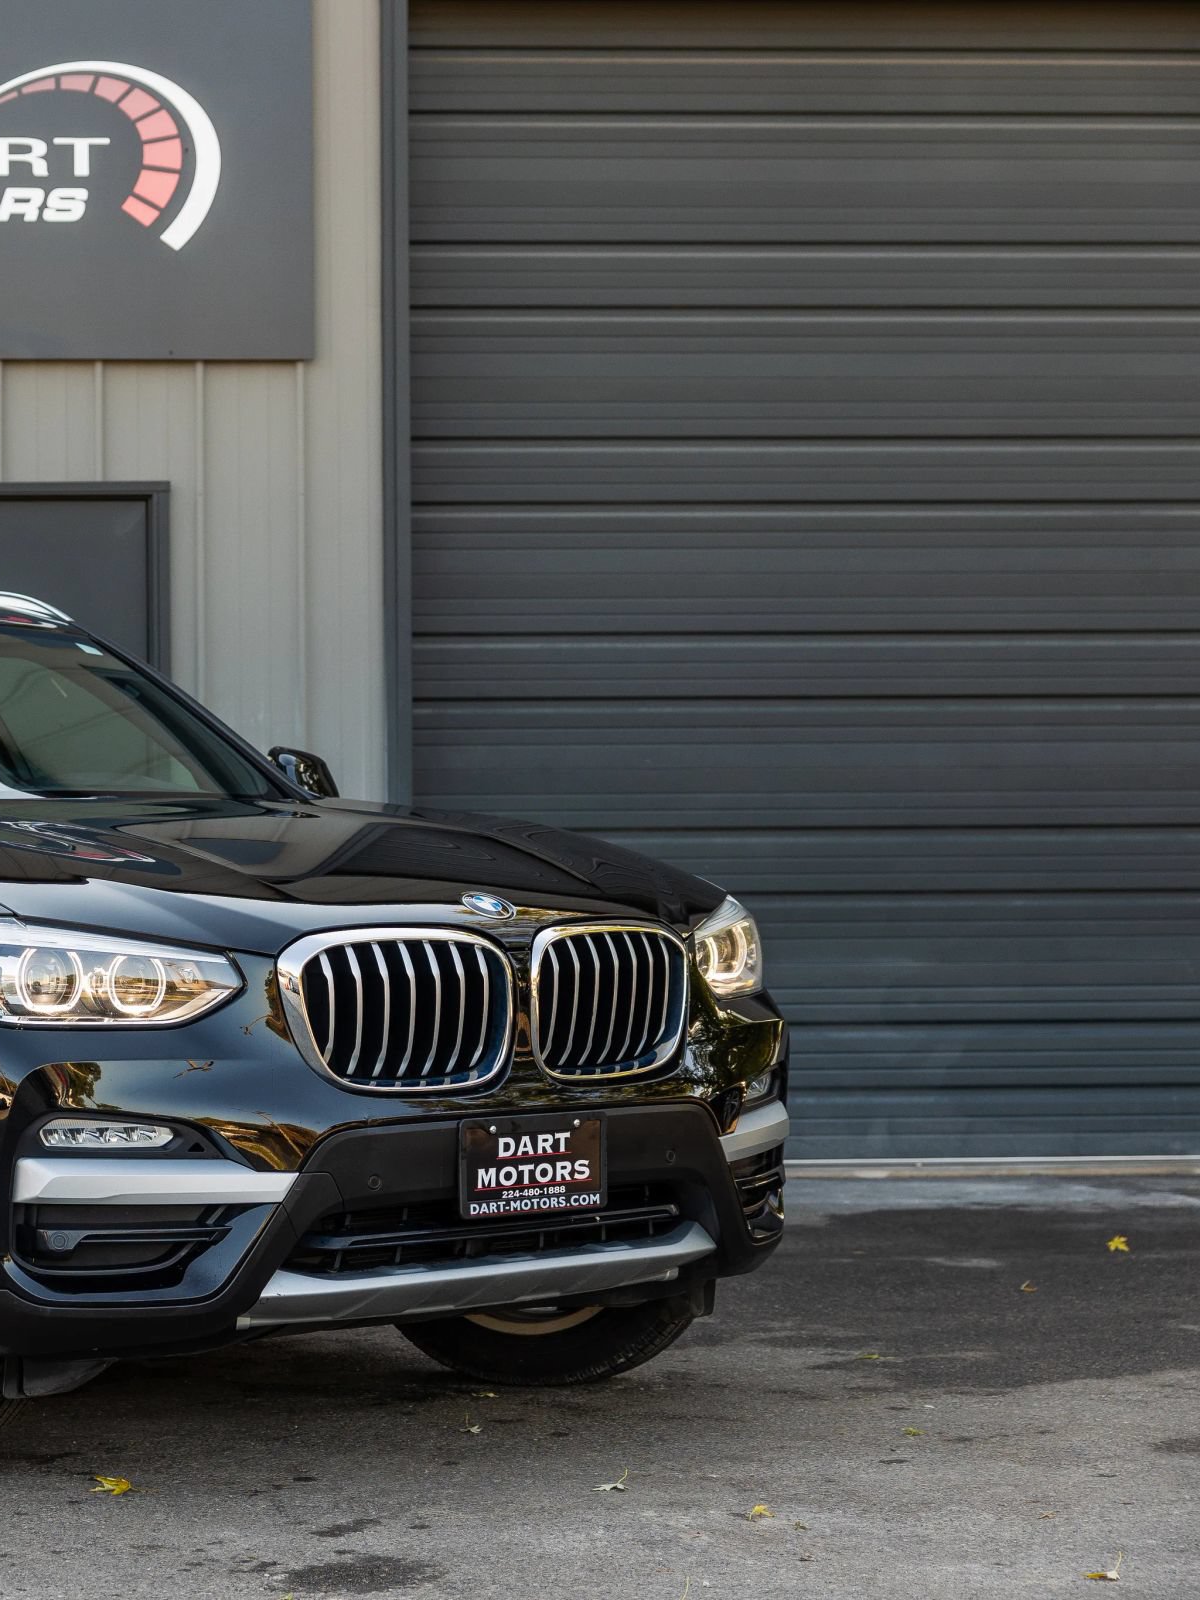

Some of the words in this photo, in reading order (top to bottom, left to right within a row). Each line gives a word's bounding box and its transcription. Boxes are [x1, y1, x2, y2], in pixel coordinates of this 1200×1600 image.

[497, 1131, 571, 1158] DART
[476, 1159, 591, 1189] MOTORS
[469, 1193, 601, 1216] DART-MOTORS.COM
[501, 1185, 567, 1199] 224-480-1888
